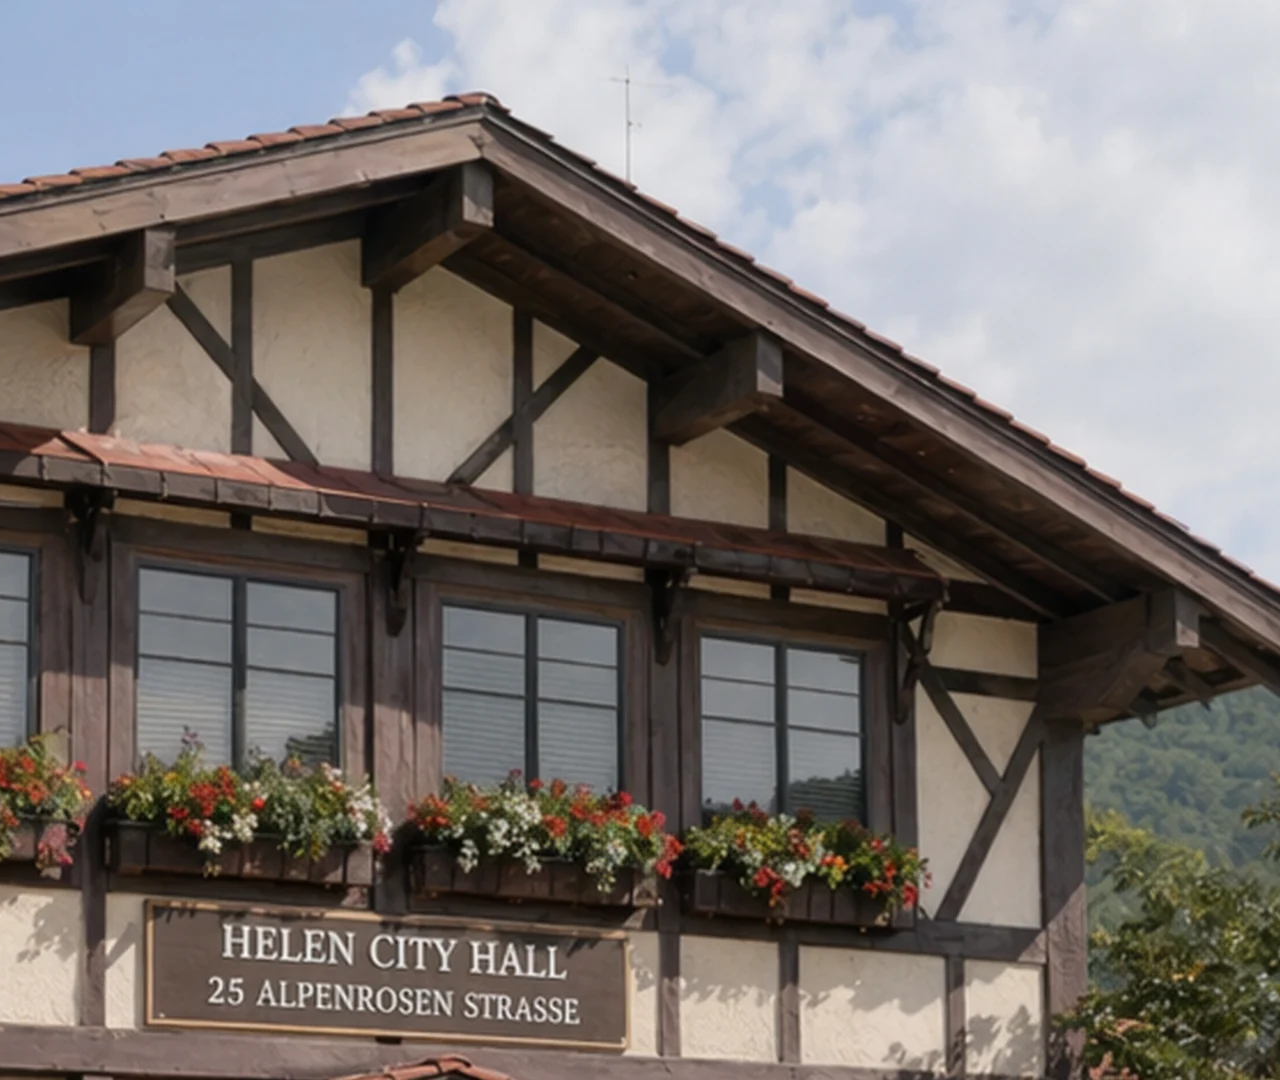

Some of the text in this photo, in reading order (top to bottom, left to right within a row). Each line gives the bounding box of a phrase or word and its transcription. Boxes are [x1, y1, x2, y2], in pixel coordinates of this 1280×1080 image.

[222, 923, 568, 980] HELEN CITY HALL
[208, 975, 581, 1025] 25 ALPENROSEN STRASSE
